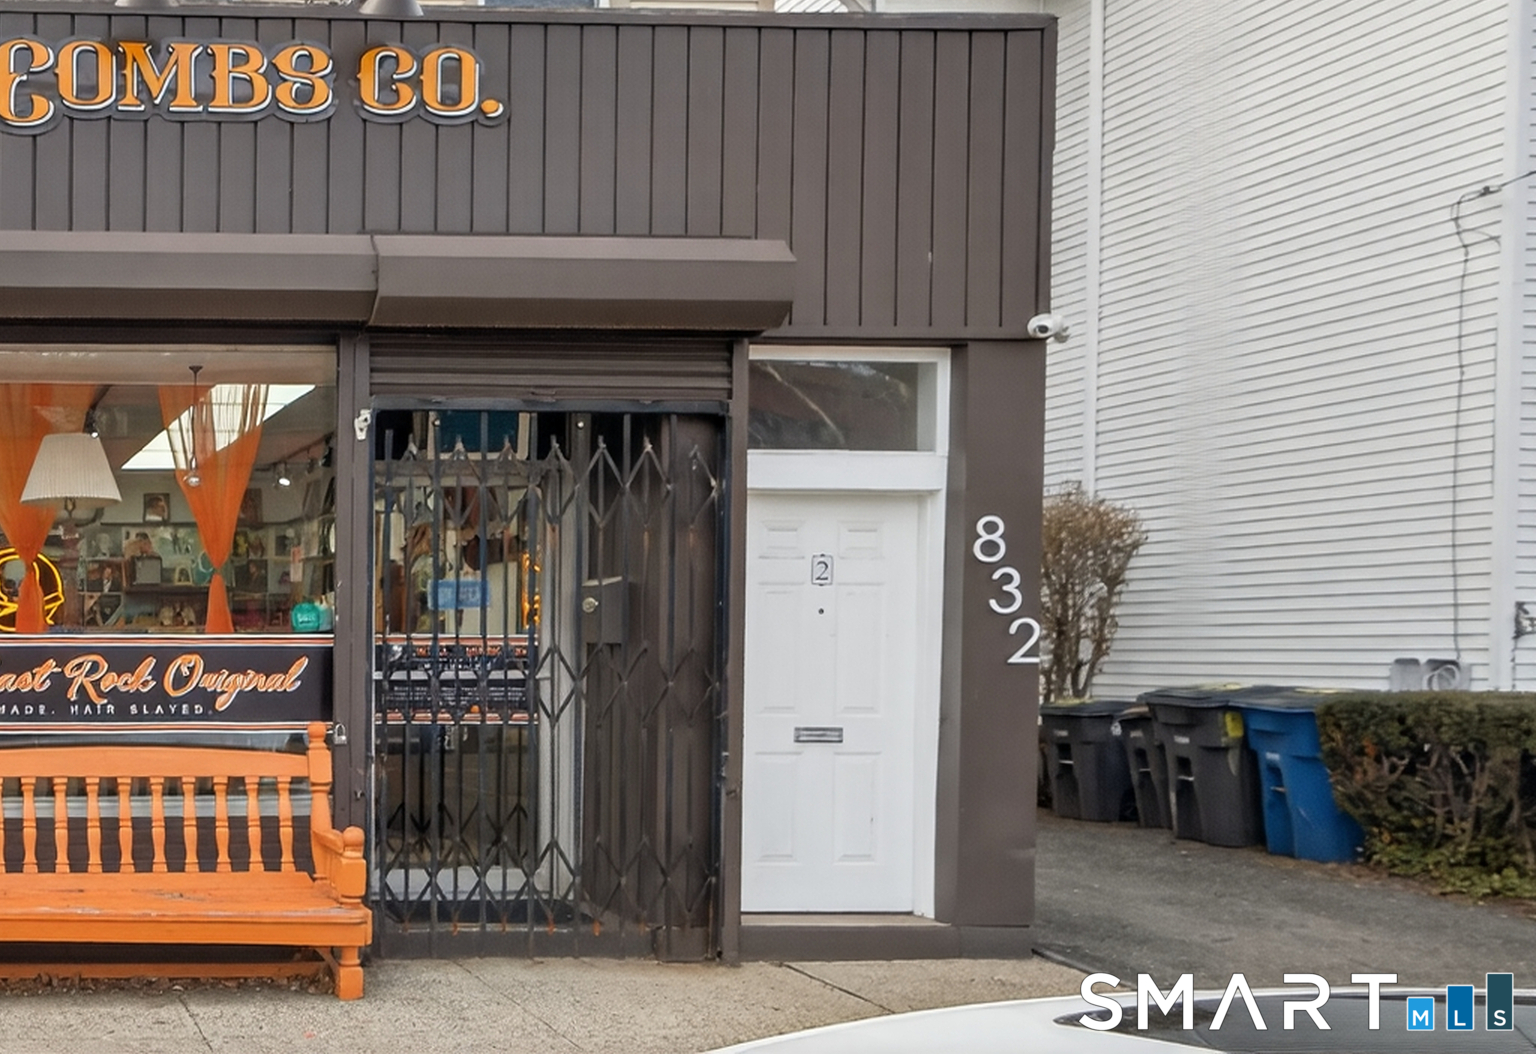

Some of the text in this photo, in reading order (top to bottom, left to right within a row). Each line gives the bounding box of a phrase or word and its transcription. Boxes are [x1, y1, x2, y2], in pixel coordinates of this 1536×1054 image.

[357, 46, 504, 117] CO.
[815, 560, 829, 581] 2
[64, 653, 157, 705] Rock
[163, 653, 309, 712] Original
[69, 703, 115, 716] HAIR
